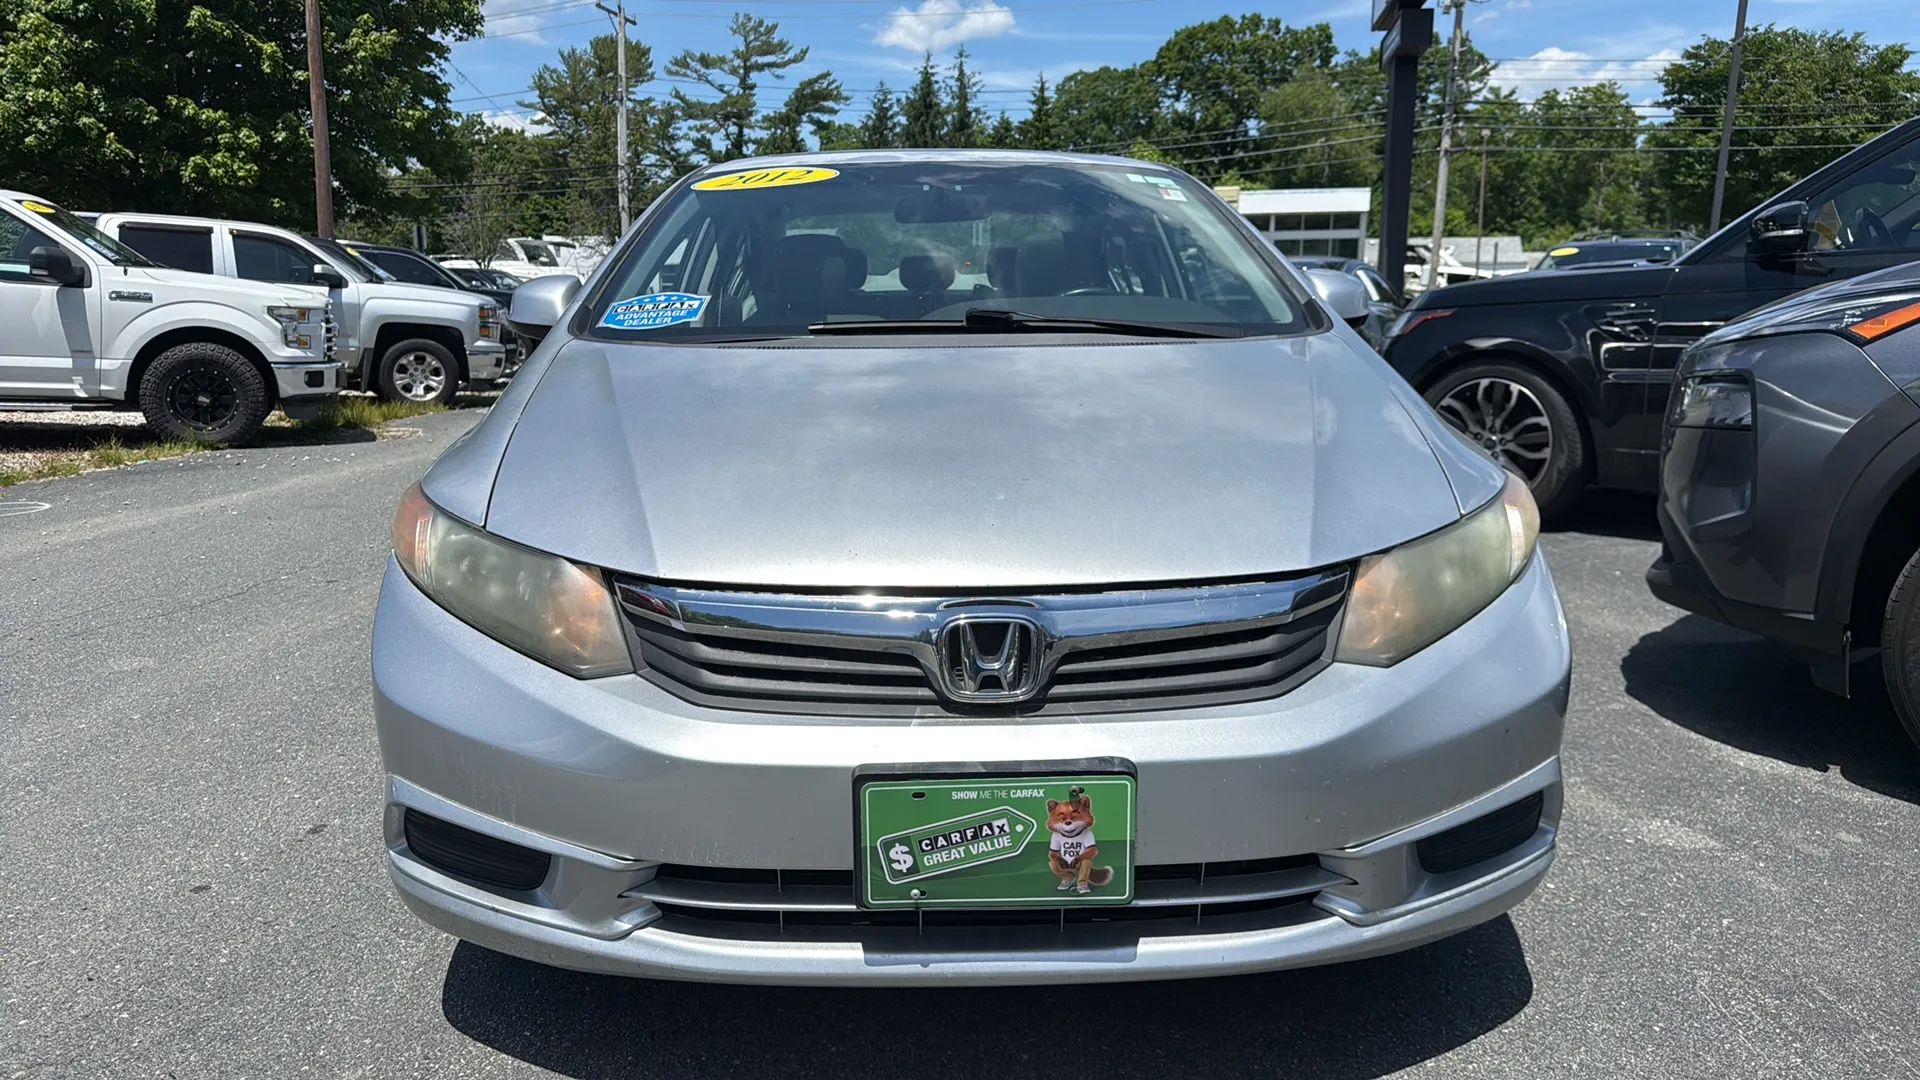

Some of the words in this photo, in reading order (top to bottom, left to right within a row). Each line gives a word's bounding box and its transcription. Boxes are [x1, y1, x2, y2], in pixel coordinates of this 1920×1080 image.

[719, 170, 813, 187] 2012
[615, 301, 698, 314] CARFAX
[615, 309, 688, 321] ADVANTAGE
[624, 317, 673, 327] DEALER
[951, 791, 978, 800] SHOW
[980, 790, 992, 799] ME
[994, 789, 1008, 799] THE
[1010, 788, 1045, 799] CARFAX
[920, 821, 1008, 852] CARFAX
[923, 846, 966, 866] GREAT
[969, 835, 1013, 855] VALUE
[1062, 841, 1082, 850] CAR
[1063, 849, 1081, 857] FOX
